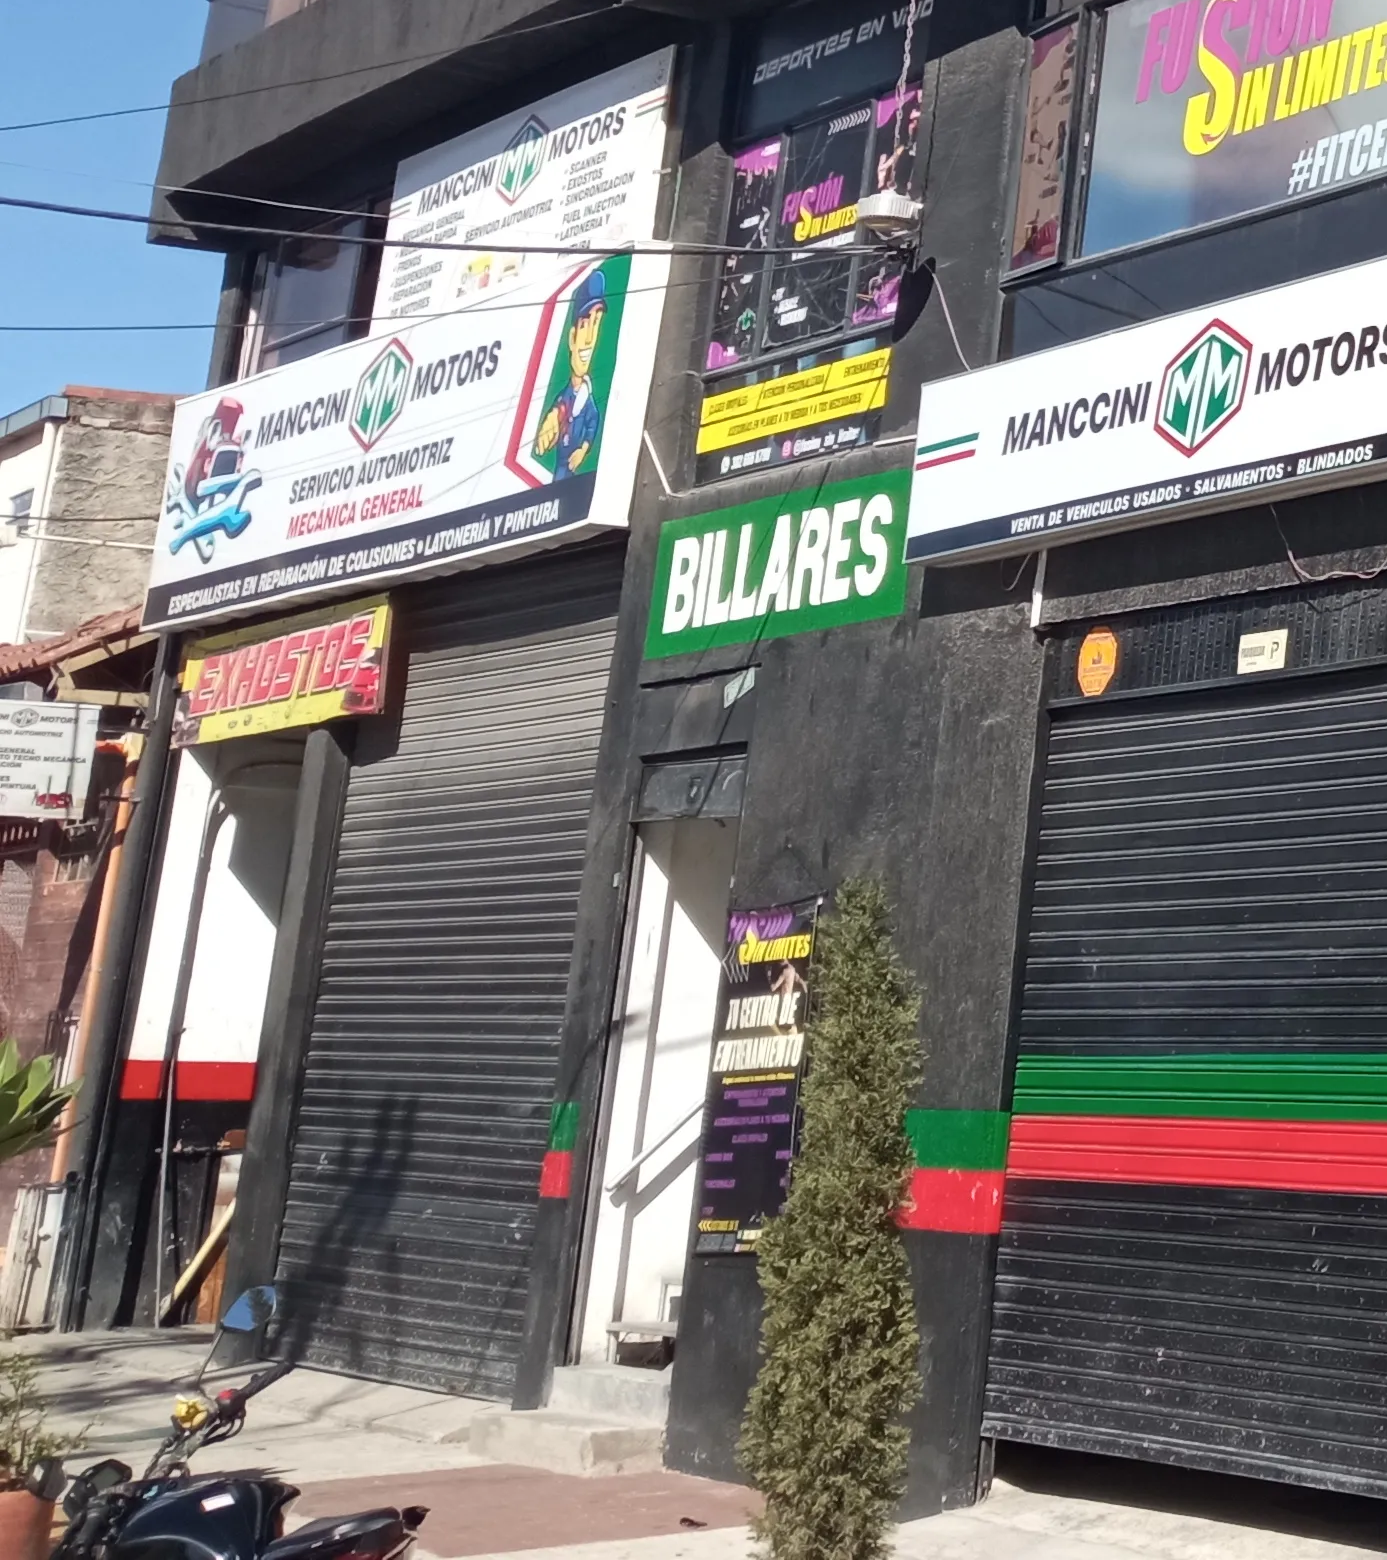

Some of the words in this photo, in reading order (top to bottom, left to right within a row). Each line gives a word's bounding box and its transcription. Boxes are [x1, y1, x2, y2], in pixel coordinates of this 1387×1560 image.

[417, 159, 497, 216] MANCCINI
[548, 106, 627, 162] MOTORS
[565, 171, 635, 206] SINCRONIZACION
[567, 168, 603, 191] EXOSTOS
[570, 151, 607, 175] SCANNER
[464, 219, 500, 243] SERVICIO
[501, 199, 553, 231] AUTOMOTRIZ
[562, 209, 581, 224] FUEL
[584, 193, 627, 217] INJECTION
[254, 388, 352, 450] MANCCINI
[410, 340, 502, 402] MOTORS
[1001, 381, 1152, 456] MANCCINI
[289, 465, 354, 505] SERVICIO
[356, 437, 454, 487] AUTOMOTRIZ
[1010, 510, 1045, 535] VENTA
[1048, 507, 1063, 526] DE
[1066, 494, 1130, 522] VEHICULOS
[1133, 484, 1181, 508] USADOS
[1194, 463, 1284, 496] SALVAMENTOS
[1297, 444, 1374, 475] BLINDADOS
[287, 501, 355, 540] MECÁNICA
[361, 484, 424, 521] GENERAL
[168, 578, 241, 616] ESPECIALISTAS
[241, 576, 258, 598] EN
[258, 555, 326, 594] REPARACIÓN
[328, 553, 345, 578] DE
[346, 539, 417, 572] COLISIONES
[424, 513, 491, 549] LATONERÍA
[493, 516, 503, 536] Y
[503, 499, 559, 536] PINTURA
[662, 494, 893, 634] BILLARES
[188, 614, 375, 718] EXHOSTOS
[40, 716, 78, 725] MOTORS
[740, 994, 779, 1029] CENTRO
[779, 992, 801, 1025] DE
[712, 1032, 805, 1072] ENTRENAMIENTO
